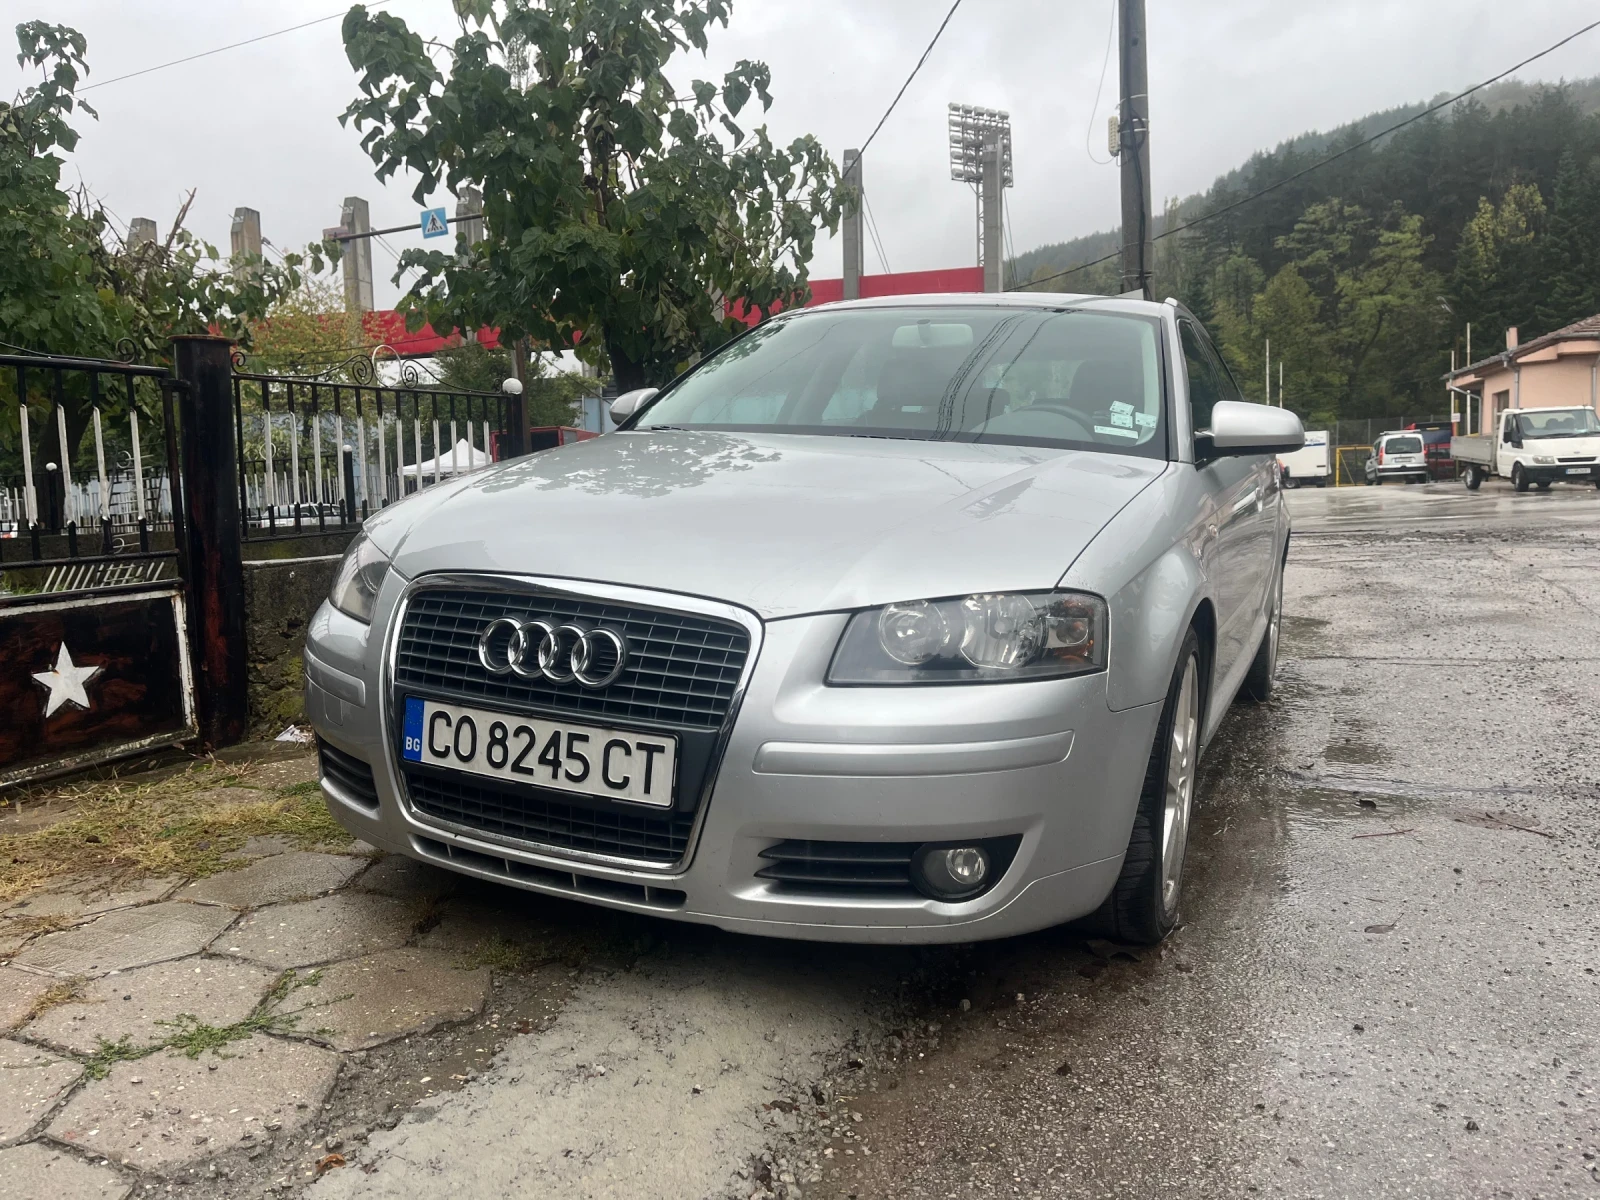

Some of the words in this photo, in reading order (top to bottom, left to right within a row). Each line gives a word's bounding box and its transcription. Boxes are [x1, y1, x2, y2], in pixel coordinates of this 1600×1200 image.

[405, 736, 420, 752] BG
[428, 710, 477, 763] CO
[486, 720, 590, 783] 8245
[602, 738, 665, 794] CT
